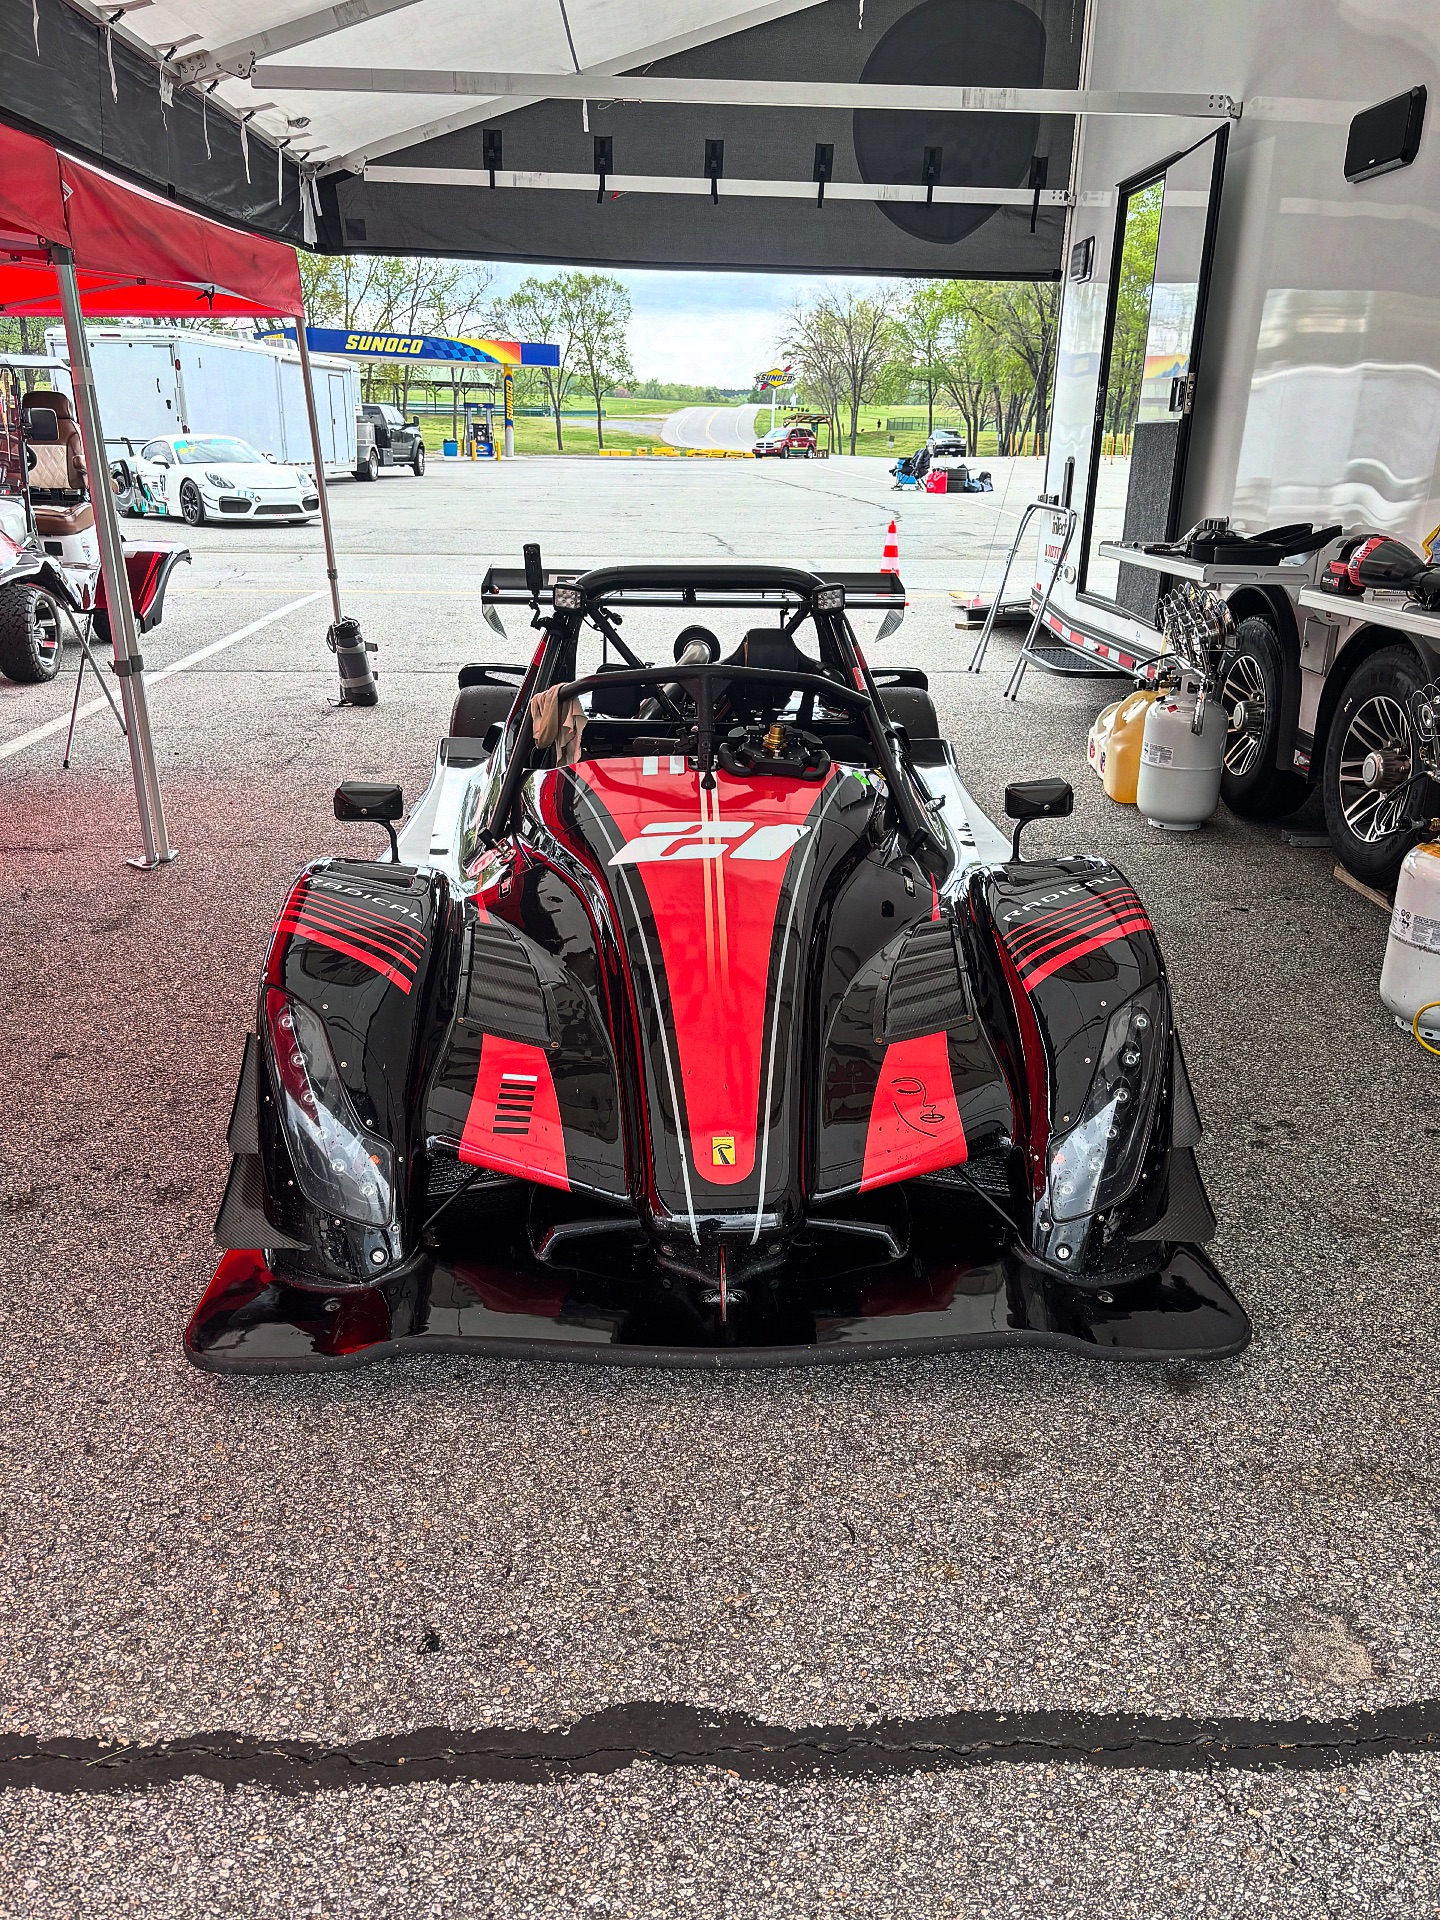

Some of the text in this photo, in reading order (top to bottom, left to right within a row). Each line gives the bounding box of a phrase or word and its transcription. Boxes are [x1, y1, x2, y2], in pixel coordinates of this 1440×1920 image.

[345, 335, 424, 354] SUNOCO
[237, 490, 255, 499] TT3
[608, 821, 811, 866] 21
[304, 877, 422, 924] RADICAL
[1003, 877, 1120, 921] RADICAL
